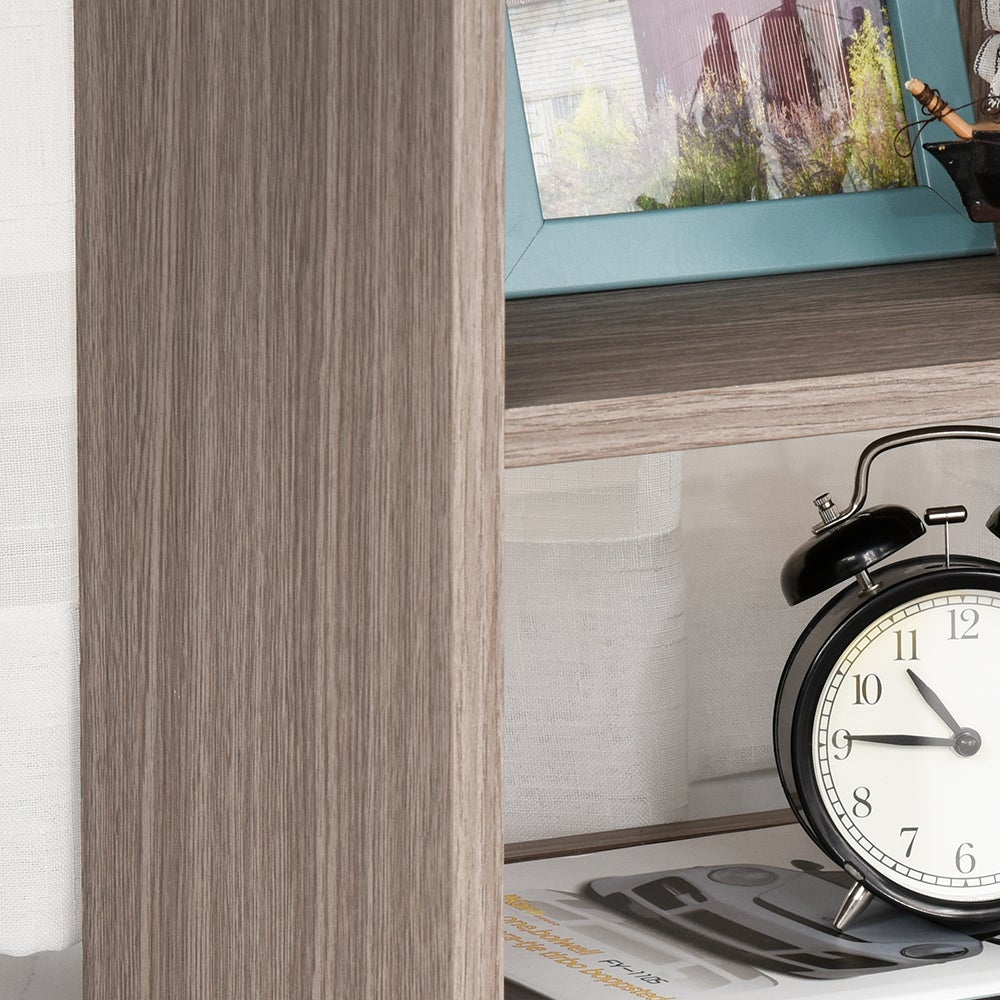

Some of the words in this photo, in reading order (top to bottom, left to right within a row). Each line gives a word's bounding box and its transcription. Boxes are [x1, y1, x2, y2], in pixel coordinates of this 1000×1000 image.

[947, 608, 979, 640] 12
[893, 629, 920, 661] 11
[852, 673, 882, 705] 10
[831, 728, 853, 760] 9
[852, 786, 872, 818] 8
[900, 827, 919, 857] 7
[955, 842, 976, 874] 6
